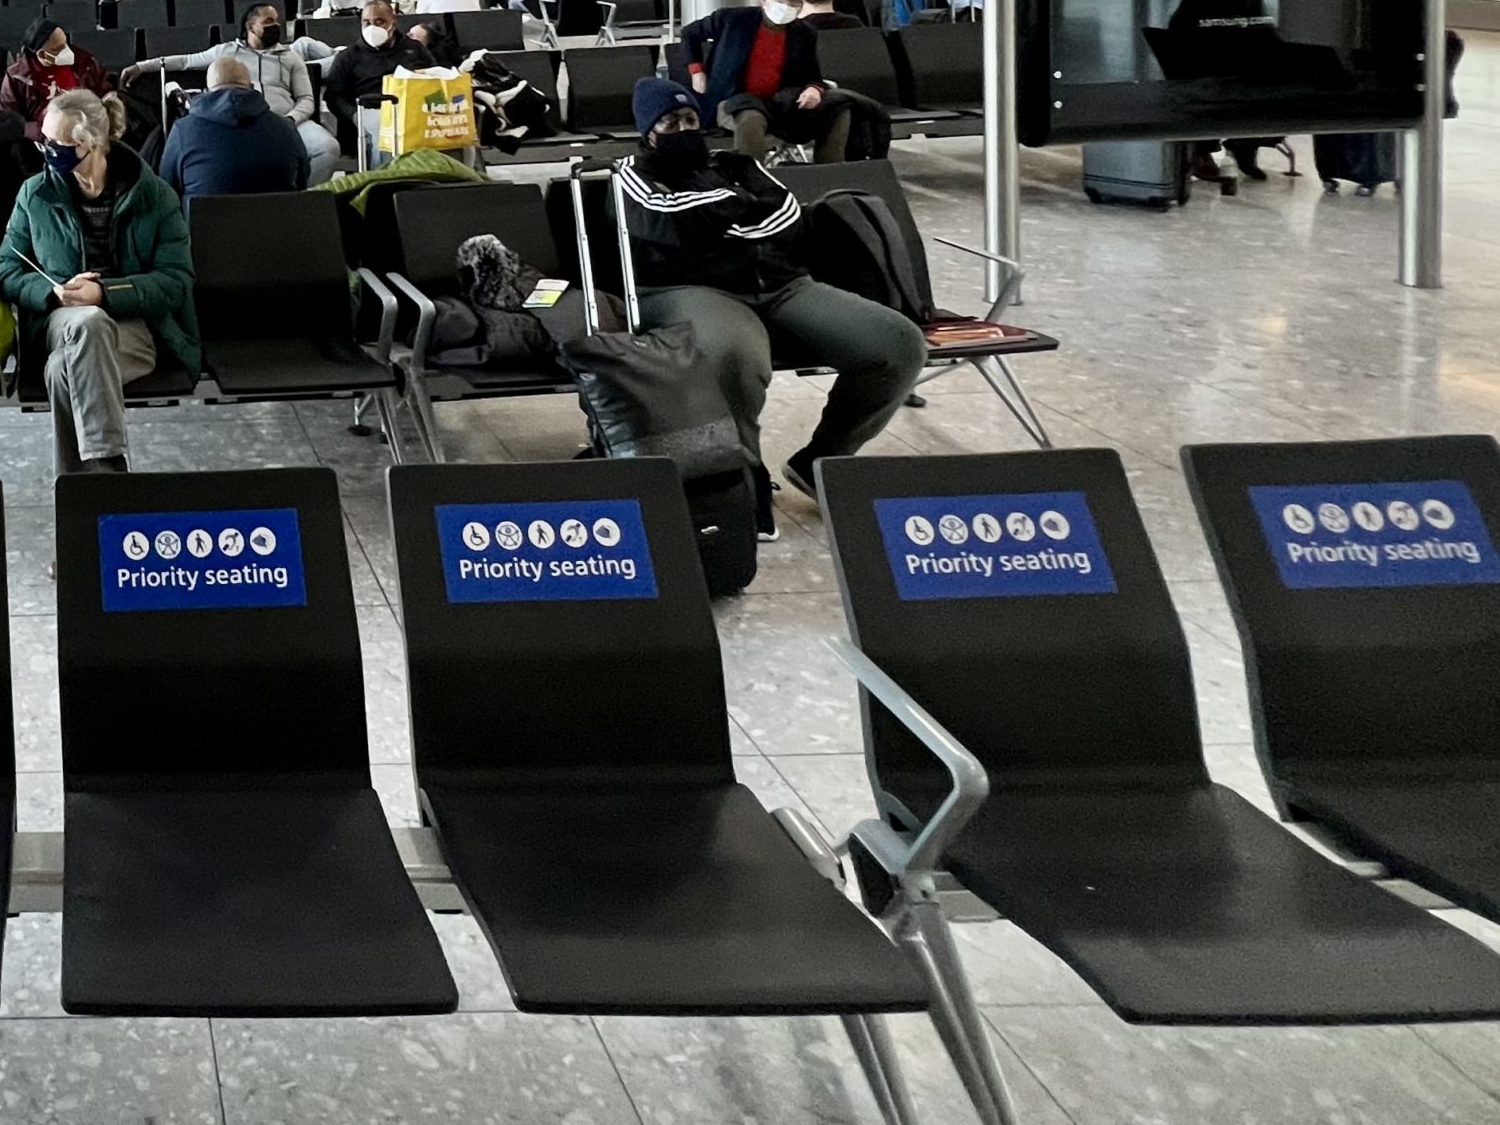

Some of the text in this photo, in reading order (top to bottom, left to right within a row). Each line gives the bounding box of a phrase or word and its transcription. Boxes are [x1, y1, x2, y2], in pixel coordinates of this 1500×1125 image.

[905, 548, 1092, 577] Priority seating
[1286, 538, 1481, 567] Priority seating
[117, 563, 288, 591] Priority seating
[459, 555, 636, 582] Priority seating
